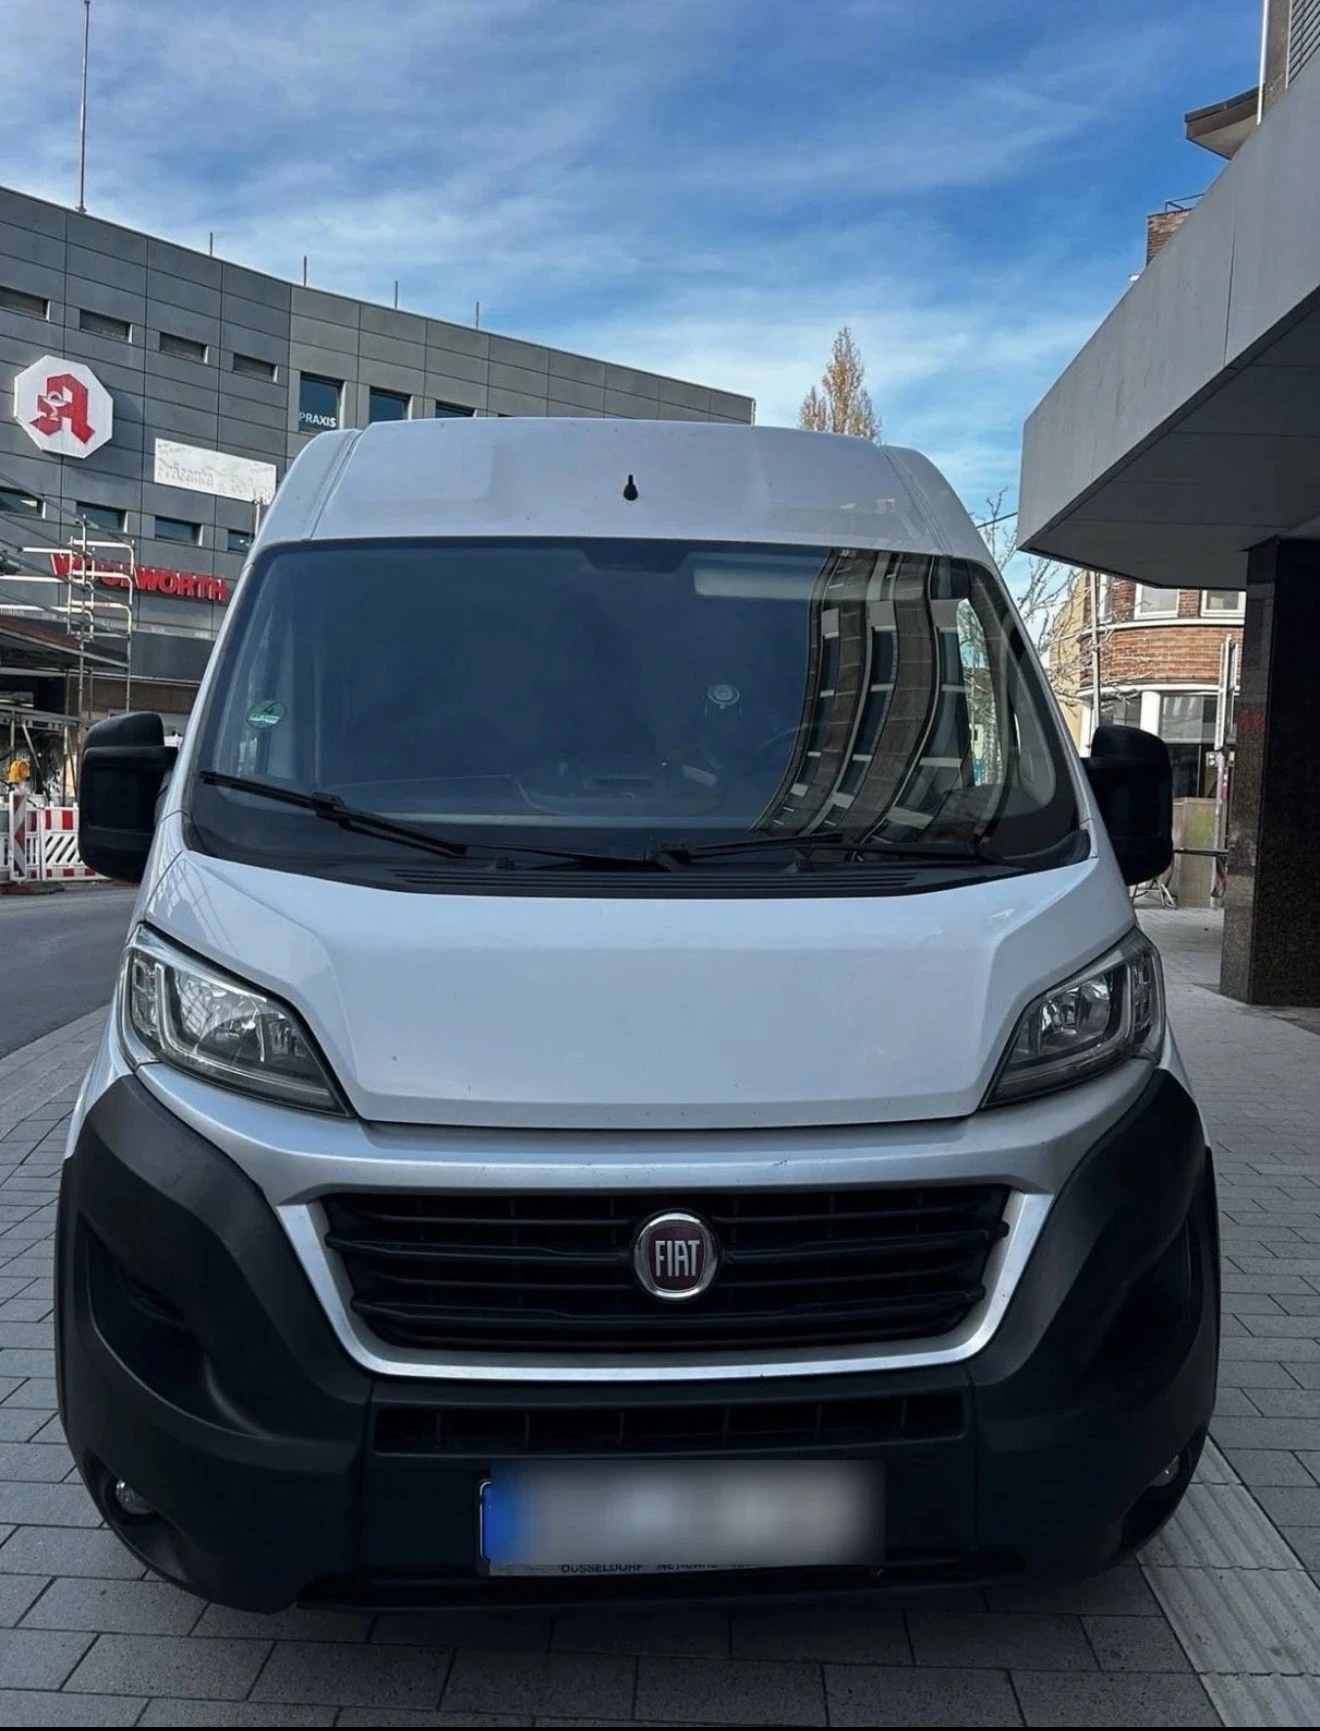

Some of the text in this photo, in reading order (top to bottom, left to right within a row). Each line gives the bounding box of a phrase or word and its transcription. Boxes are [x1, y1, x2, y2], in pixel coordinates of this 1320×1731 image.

[299, 412, 337, 428] PRAXIS
[50, 552, 226, 601] WLWORTH
[655, 1240, 700, 1277] FIAT
